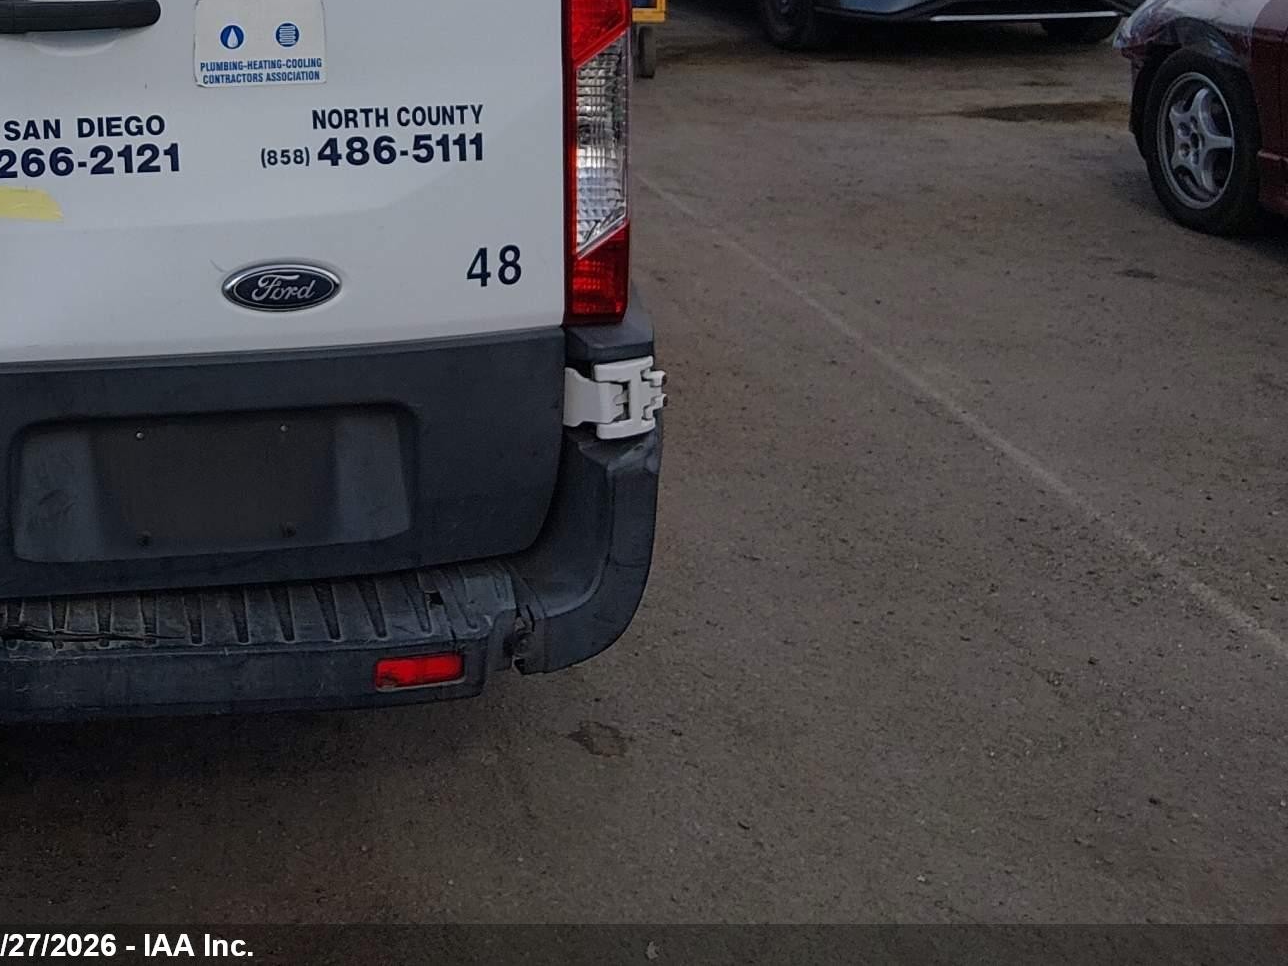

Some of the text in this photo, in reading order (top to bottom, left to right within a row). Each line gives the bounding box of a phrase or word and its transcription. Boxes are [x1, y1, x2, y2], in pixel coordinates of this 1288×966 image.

[200, 57, 323, 72] PLUMBING-HEATING-COOLING
[202, 70, 321, 85] CONTRACTORS ASSOCIATION
[3, 114, 166, 142] SAN DIEGO
[311, 104, 484, 130] NORTH COUNTY
[260, 132, 485, 169] (858) 486-5111
[466, 244, 523, 289] 48
[251, 274, 316, 301] Ford
